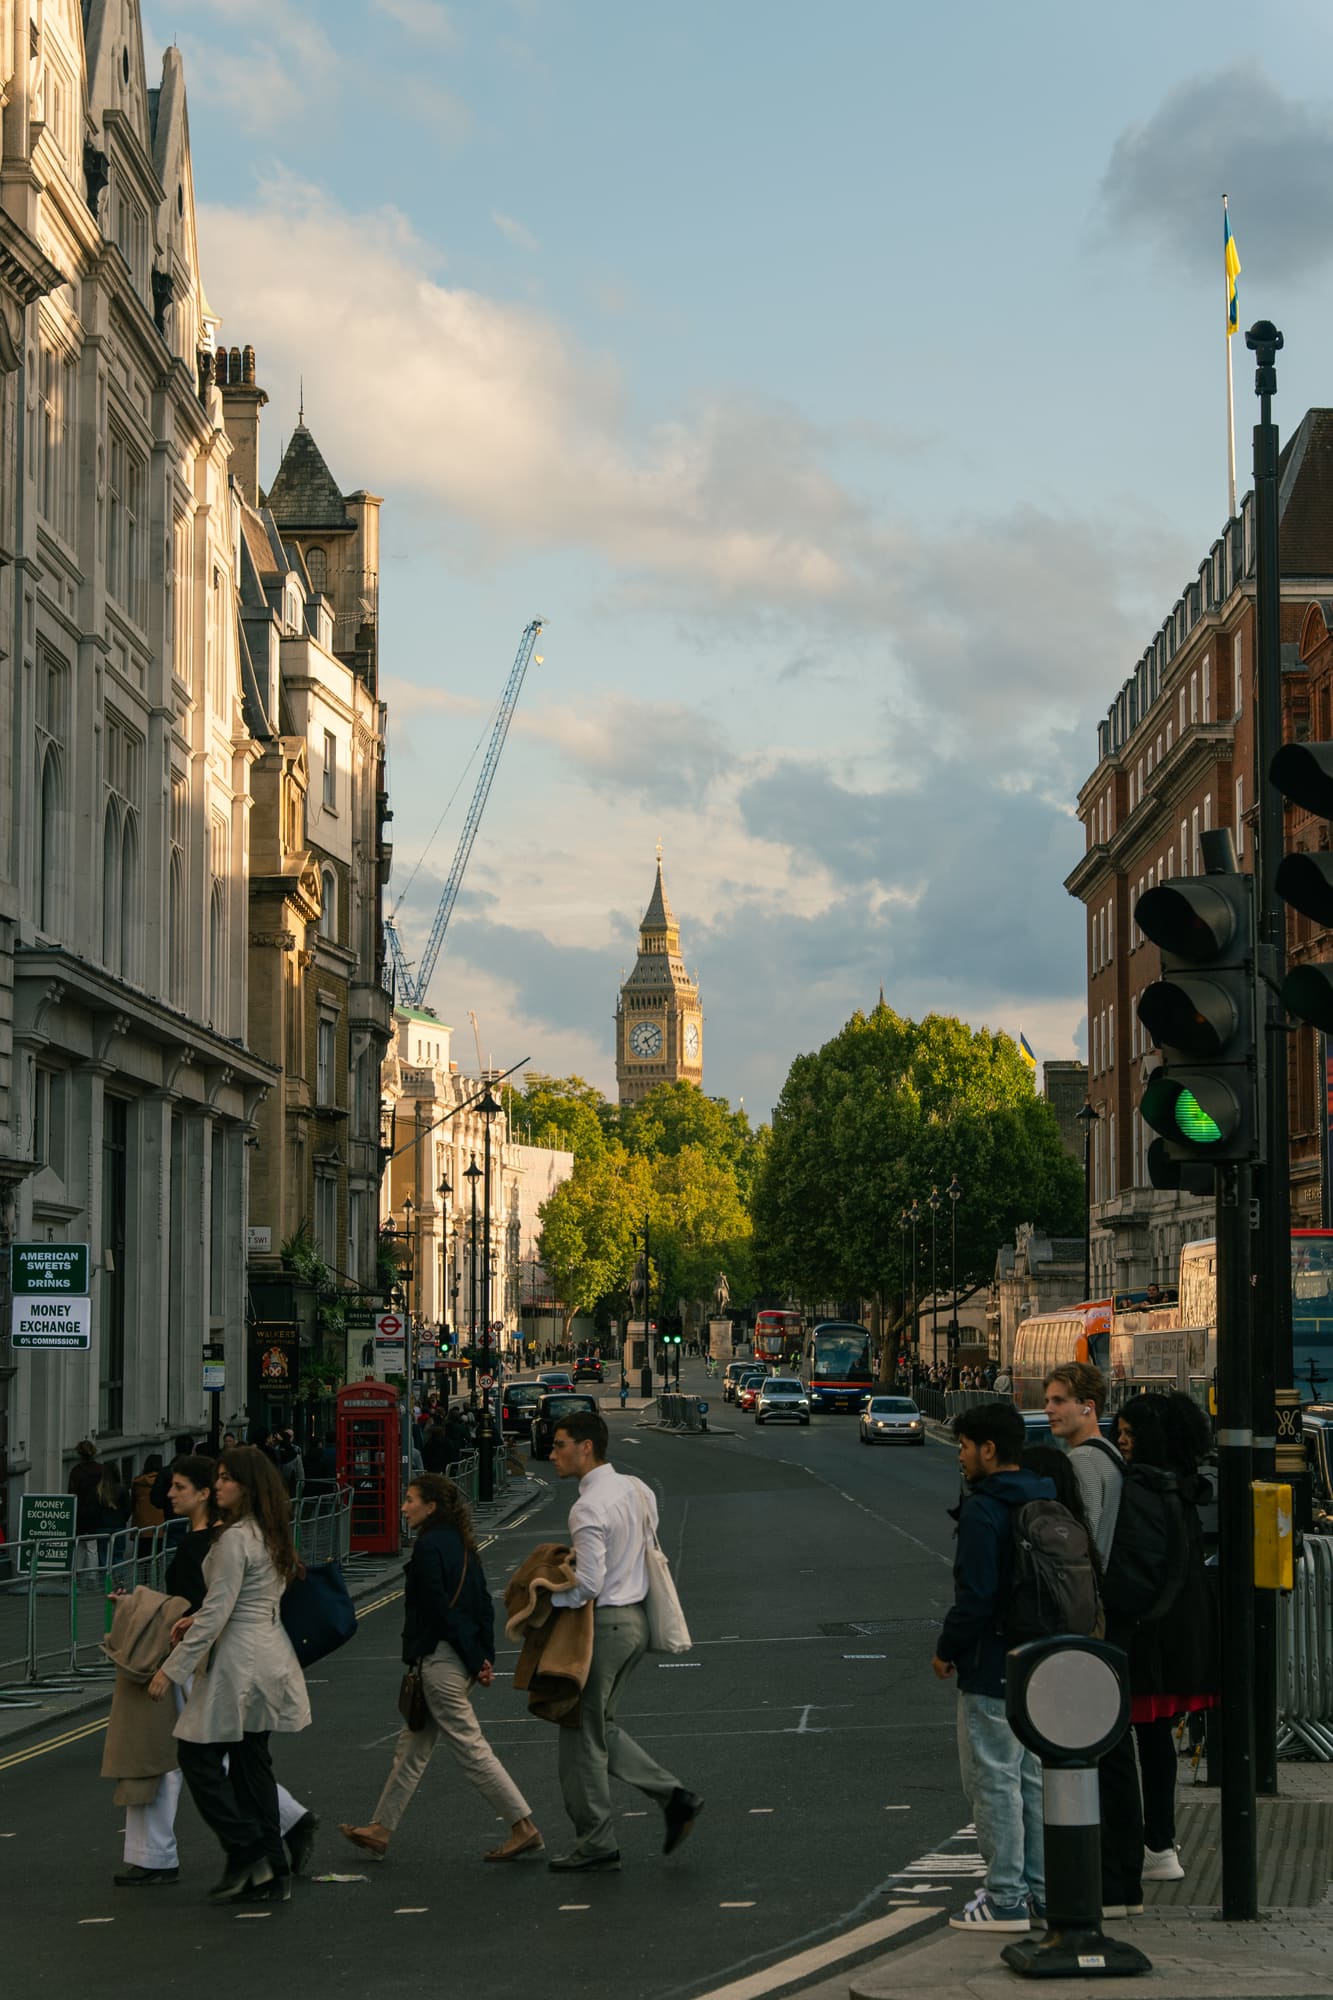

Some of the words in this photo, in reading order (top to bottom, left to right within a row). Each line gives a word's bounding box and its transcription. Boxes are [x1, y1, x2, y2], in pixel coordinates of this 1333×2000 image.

[253, 1236, 268, 1244] SW1
[19, 1252, 79, 1261] AMERICAN
[26, 1262, 72, 1270] SWEETS
[44, 1270, 54, 1279] &
[27, 1279, 71, 1288] DRINKS
[30, 1304, 71, 1317] MONEY
[19, 1320, 81, 1333] EXCHANGE
[256, 1330, 296, 1338] WALKERS
[20, 1337, 31, 1345] 0%
[32, 1337, 80, 1345] COMMISSION
[34, 1500, 65, 1509] MONEY
[27, 1510, 71, 1520] EXCHANGE
[39, 1520, 57, 1530] 0%
[29, 1529, 67, 1537] Commission
